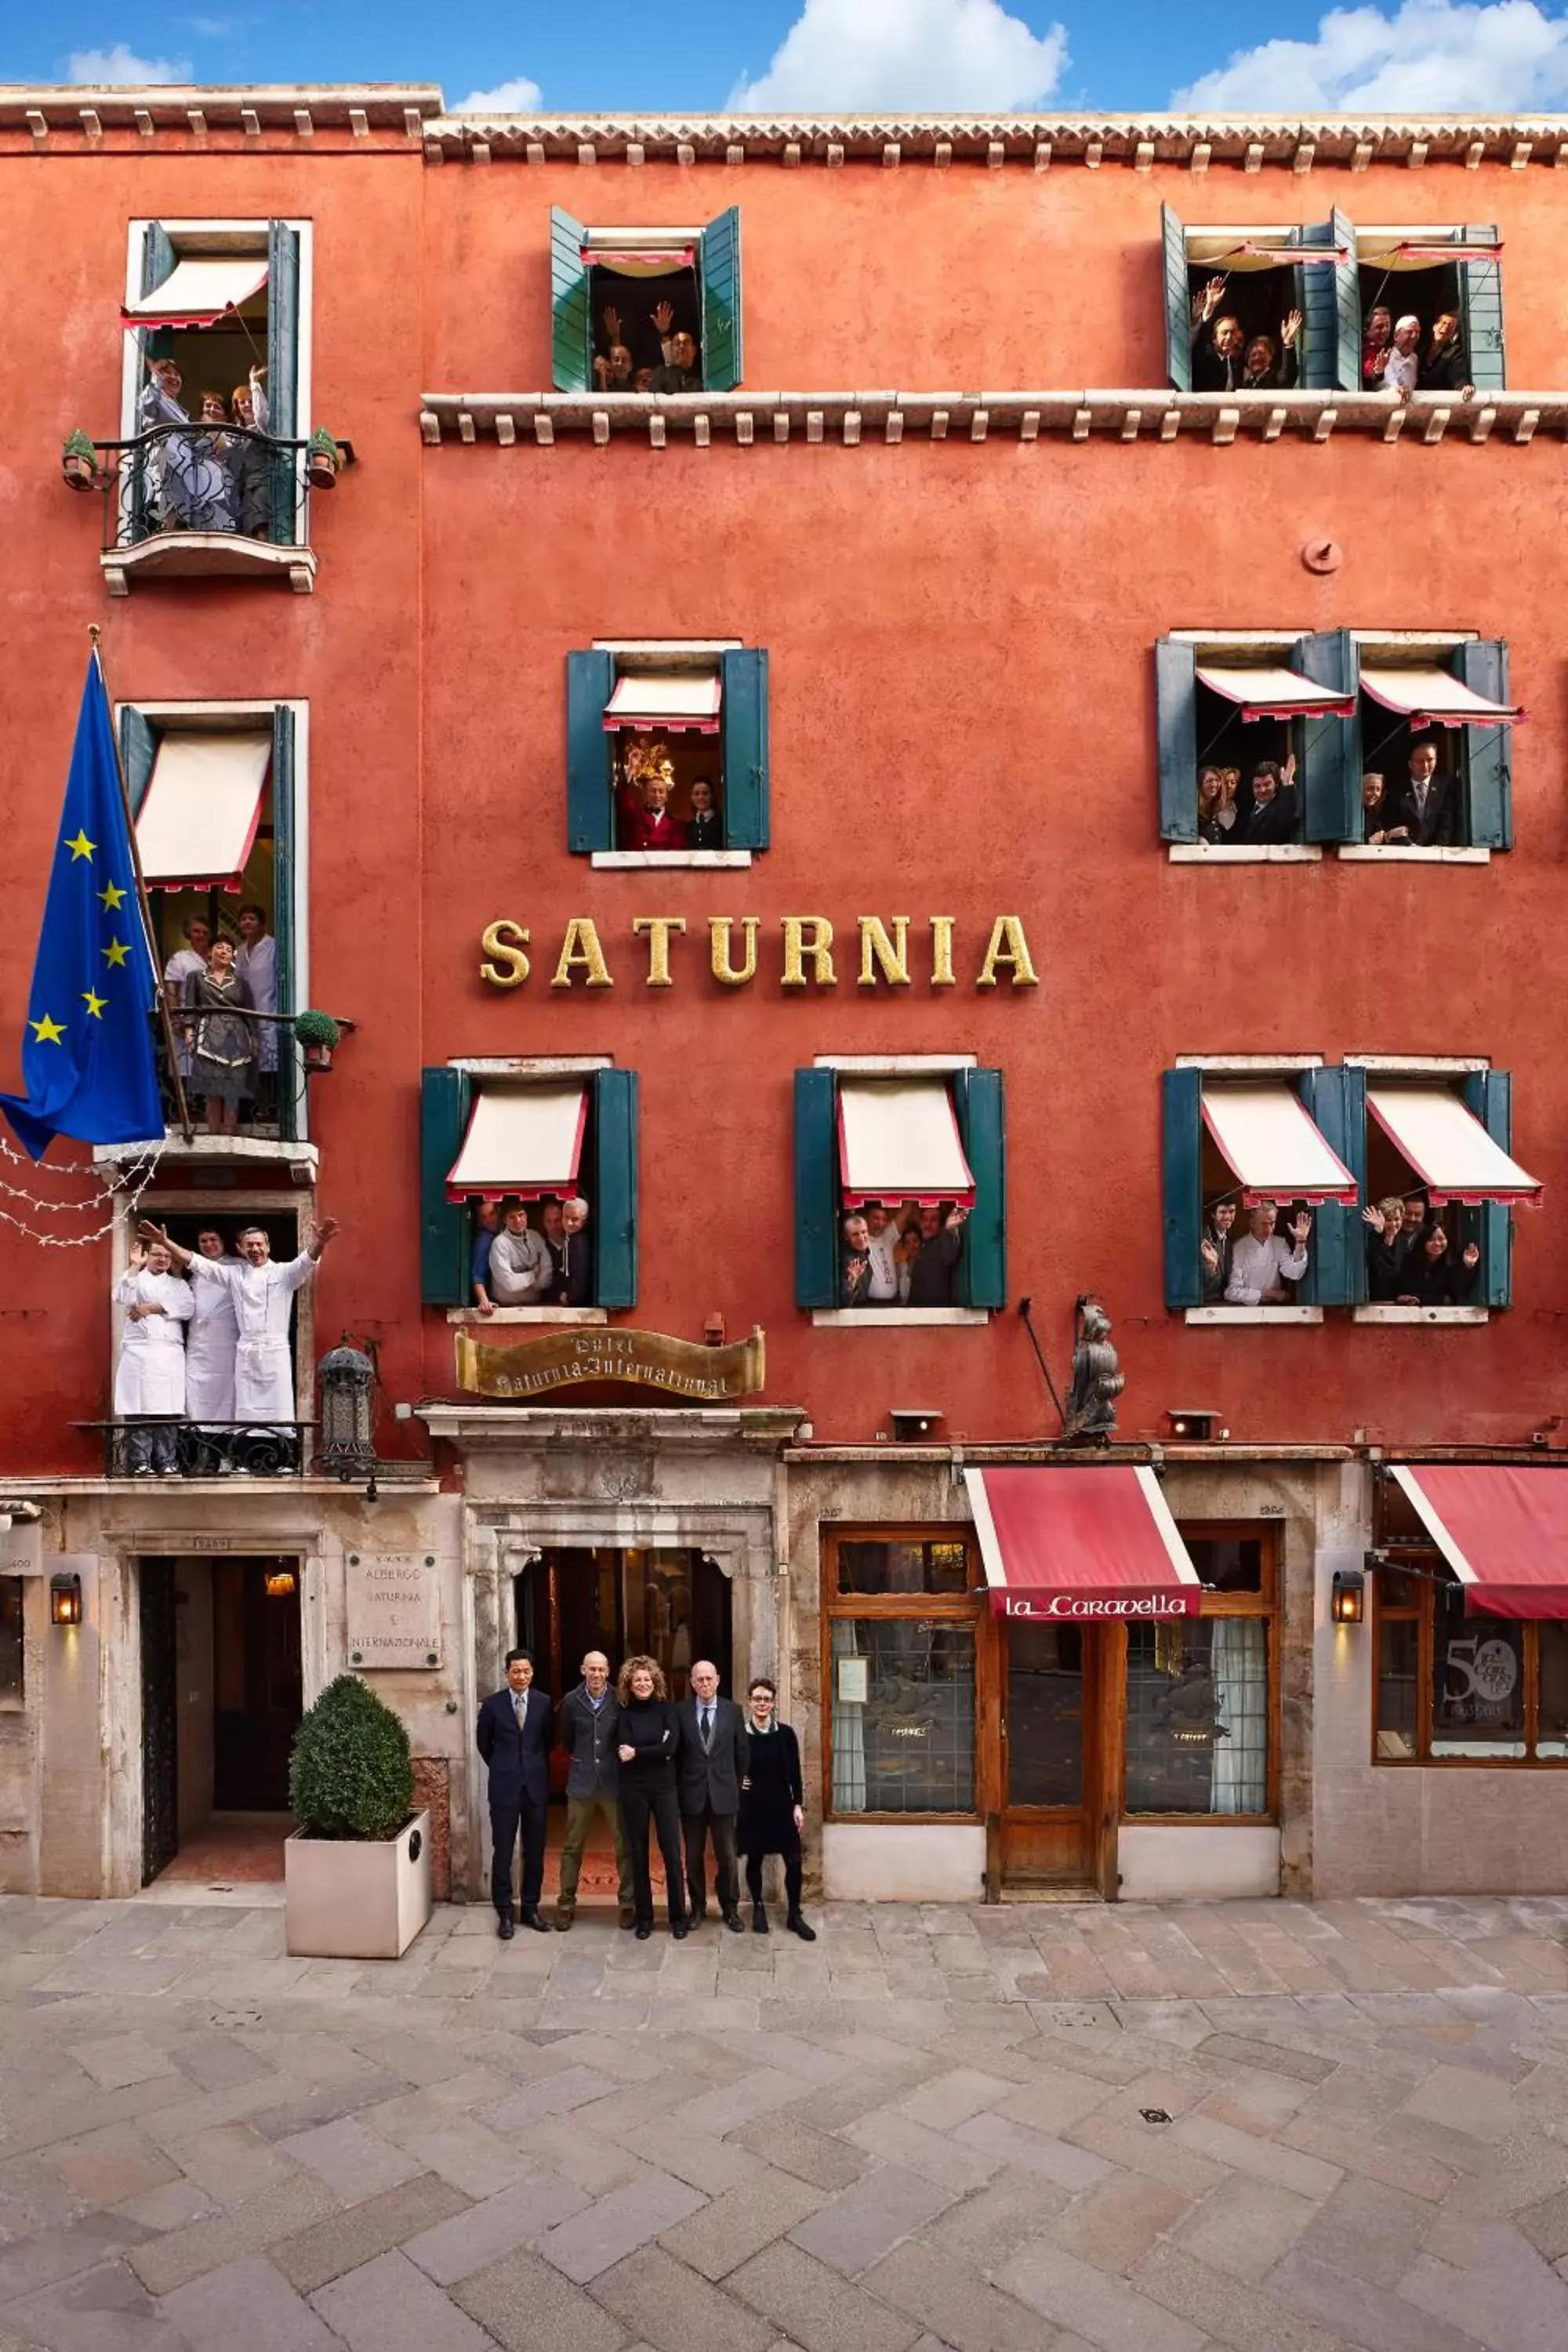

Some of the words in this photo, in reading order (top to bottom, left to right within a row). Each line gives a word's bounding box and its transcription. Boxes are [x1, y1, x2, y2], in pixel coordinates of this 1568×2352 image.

[480, 916, 1039, 987] SATURNIA
[365, 1569, 421, 1580] ALBERGO
[350, 1635, 440, 1649] NTERNAZIONALE
